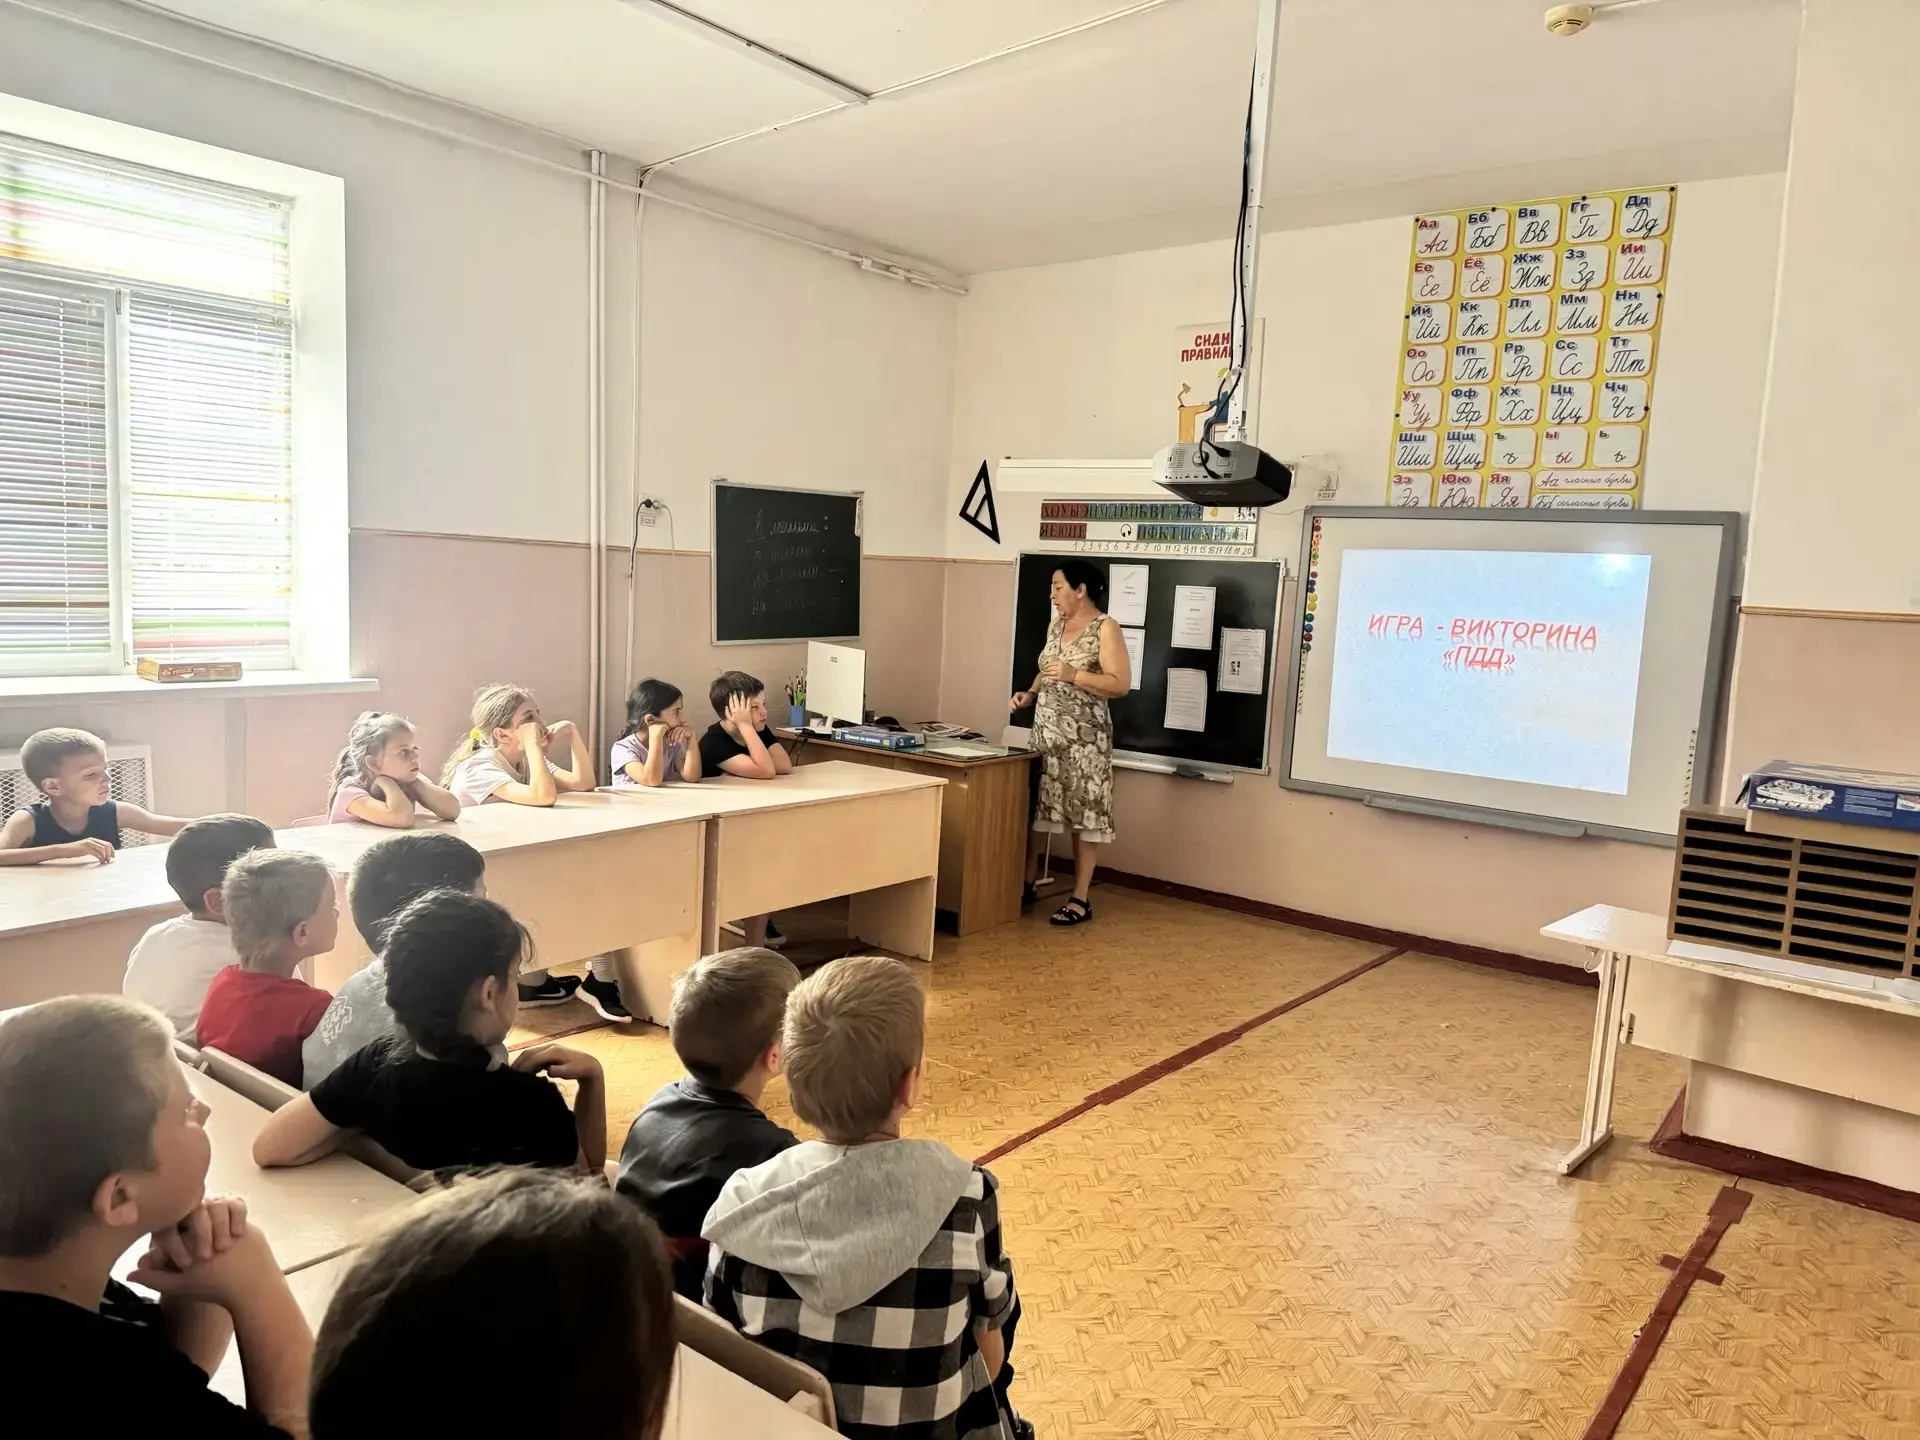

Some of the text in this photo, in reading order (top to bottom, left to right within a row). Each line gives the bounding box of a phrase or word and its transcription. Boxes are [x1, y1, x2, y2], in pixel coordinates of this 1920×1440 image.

[1368, 614, 1423, 633] ИГРА
[1450, 618, 1597, 645] ВИКТОРИНА
[1443, 646, 1516, 669] «ПДД»
